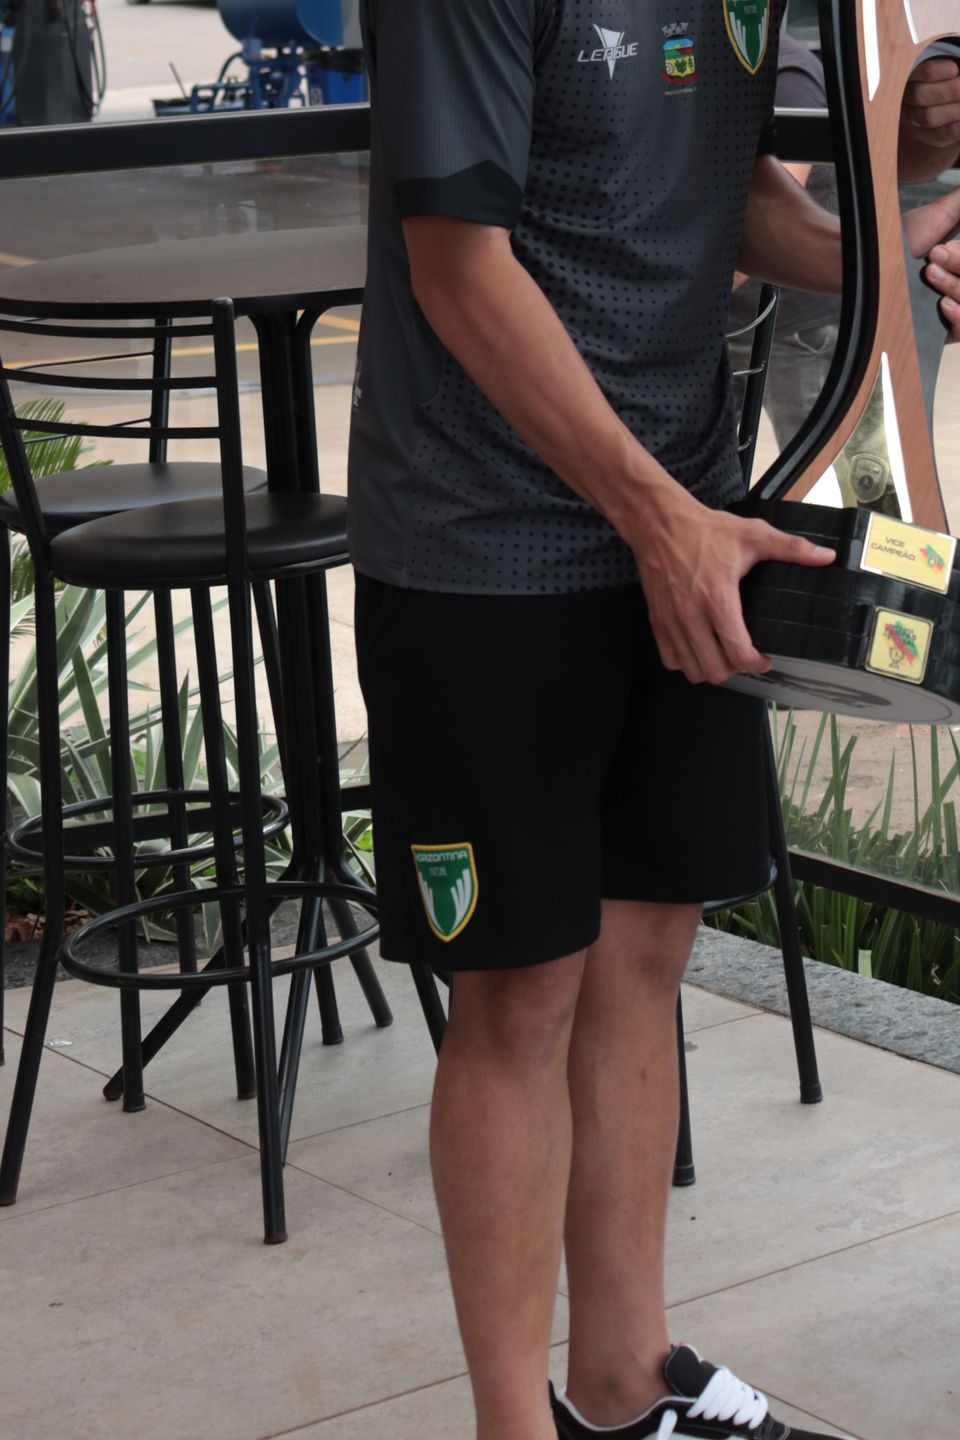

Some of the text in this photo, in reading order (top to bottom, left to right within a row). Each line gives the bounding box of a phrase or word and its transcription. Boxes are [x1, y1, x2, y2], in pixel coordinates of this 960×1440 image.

[577, 42, 639, 63] LEAGUE
[870, 542, 916, 561] CAMPEÃO
[885, 537, 905, 548] VICE
